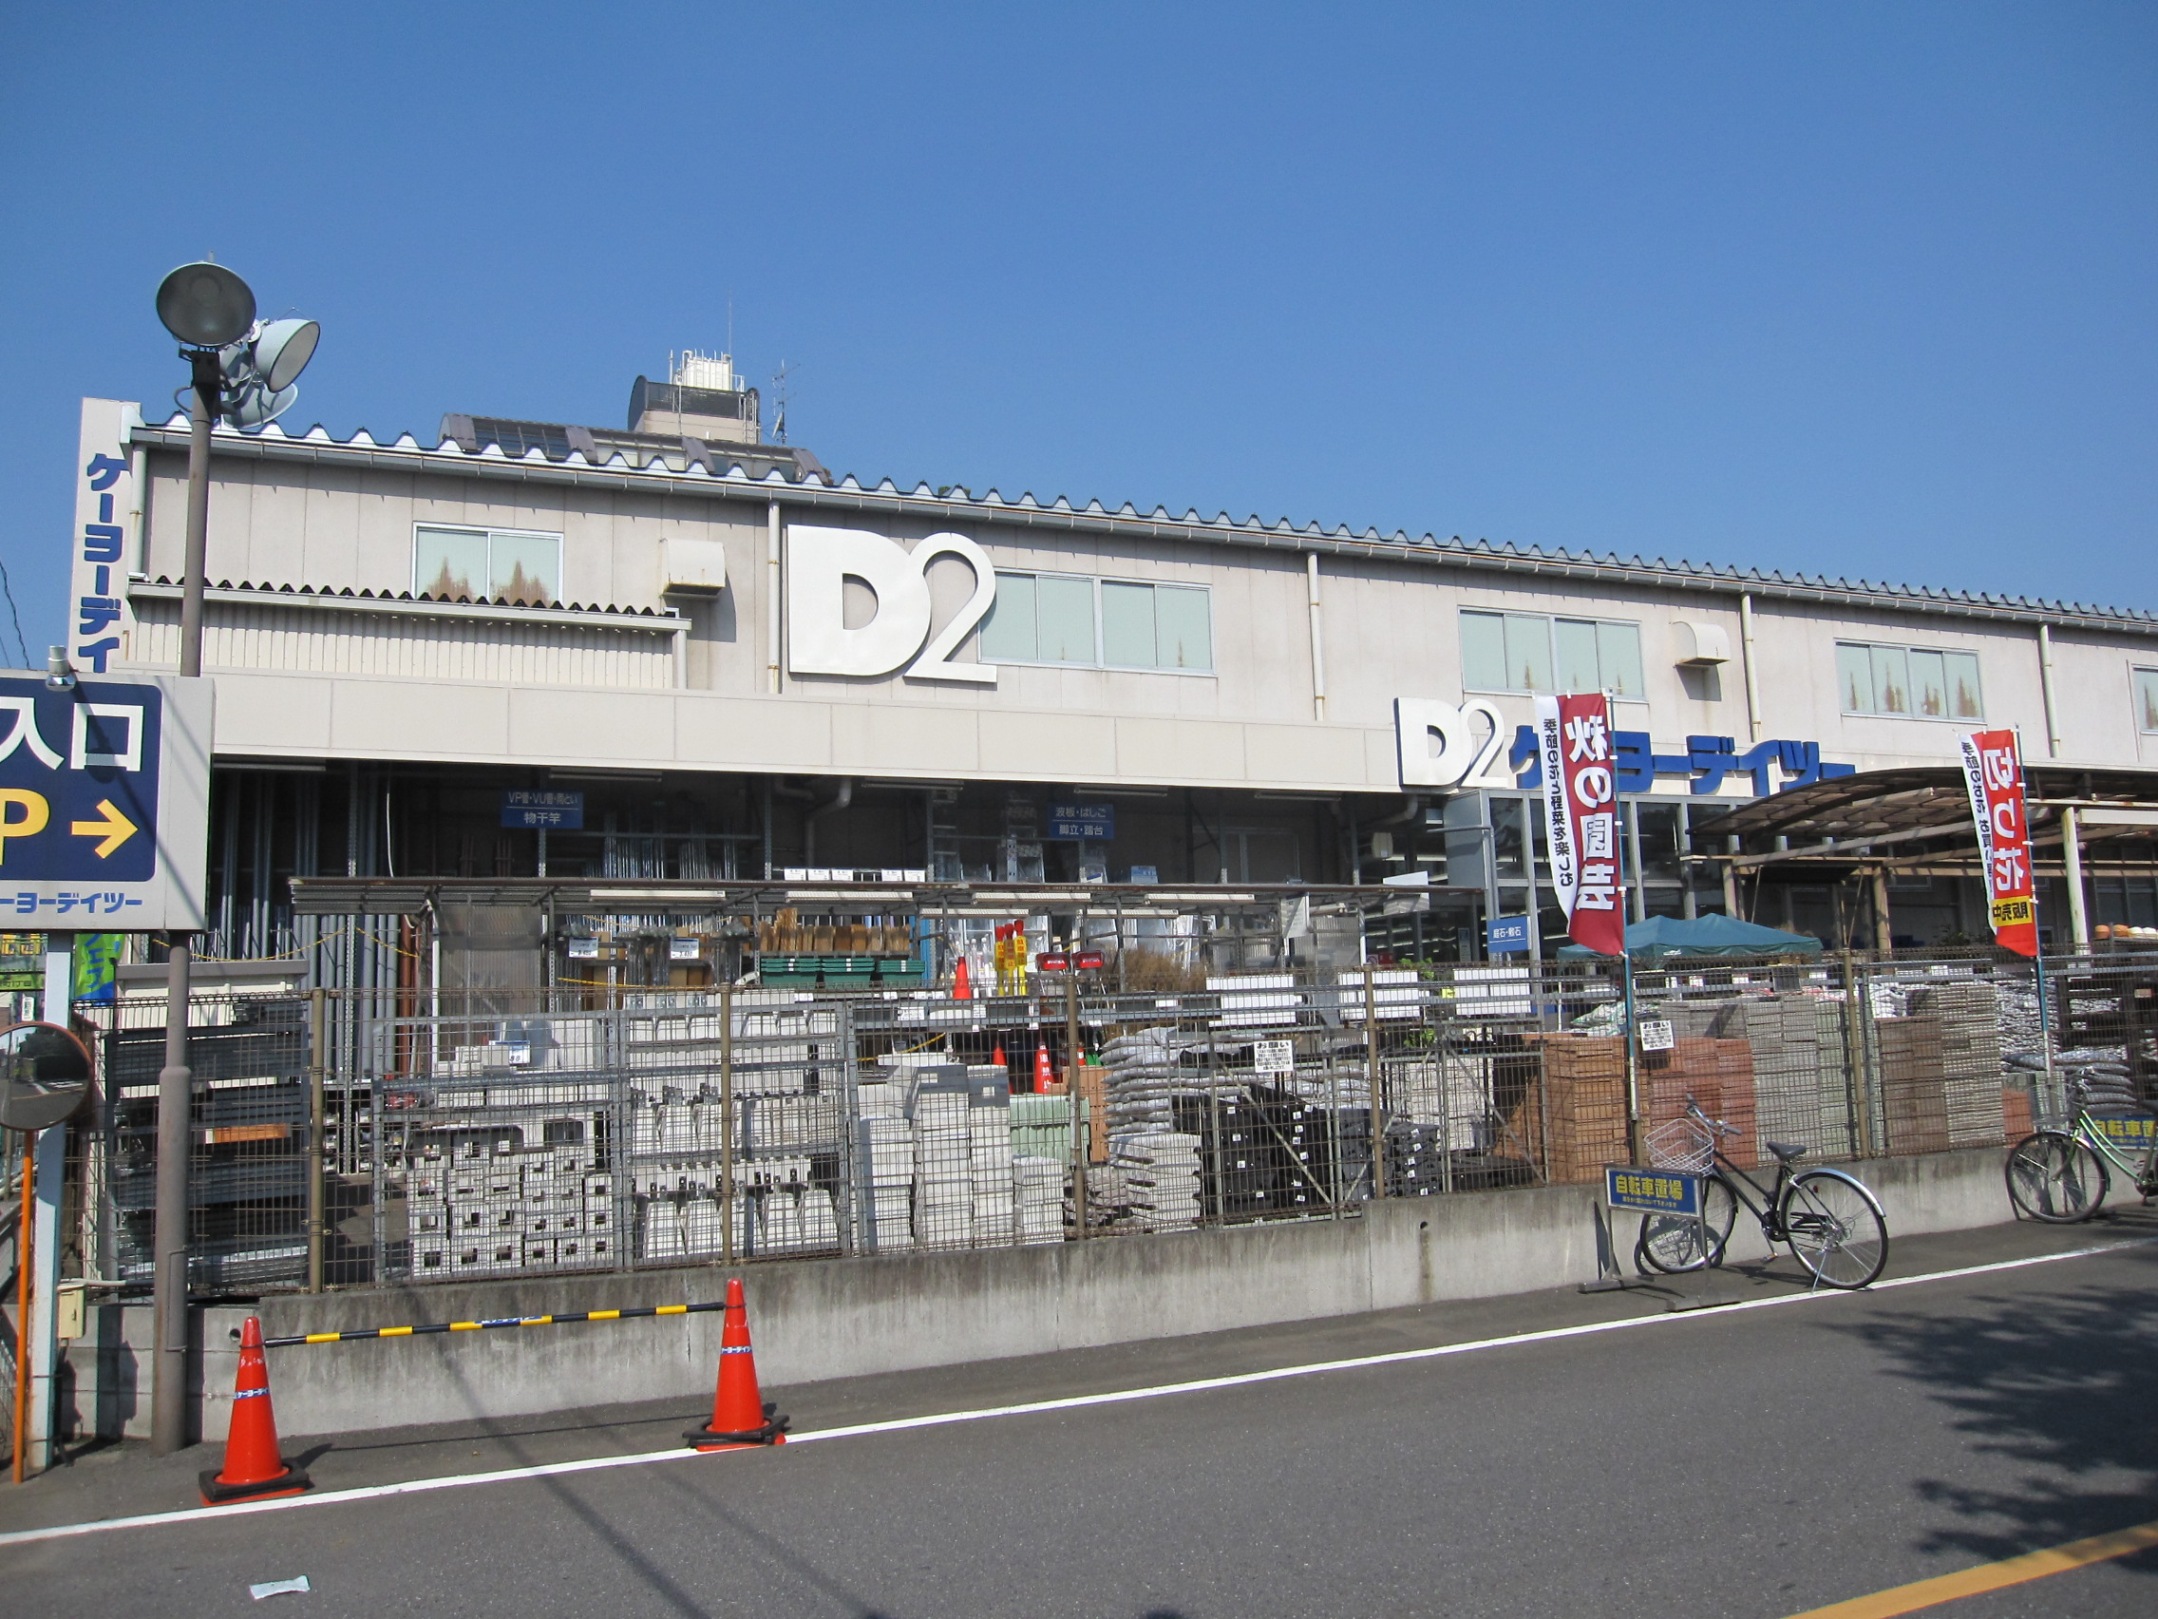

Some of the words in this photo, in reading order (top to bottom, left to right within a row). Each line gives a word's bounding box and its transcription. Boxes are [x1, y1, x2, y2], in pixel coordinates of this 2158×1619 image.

[787, 524, 997, 683] D2
[0, 697, 144, 772] 入口
[1393, 697, 1508, 788] D2
[0, 788, 50, 866] P
[1616, 1175, 1683, 1200] 自転車置場
